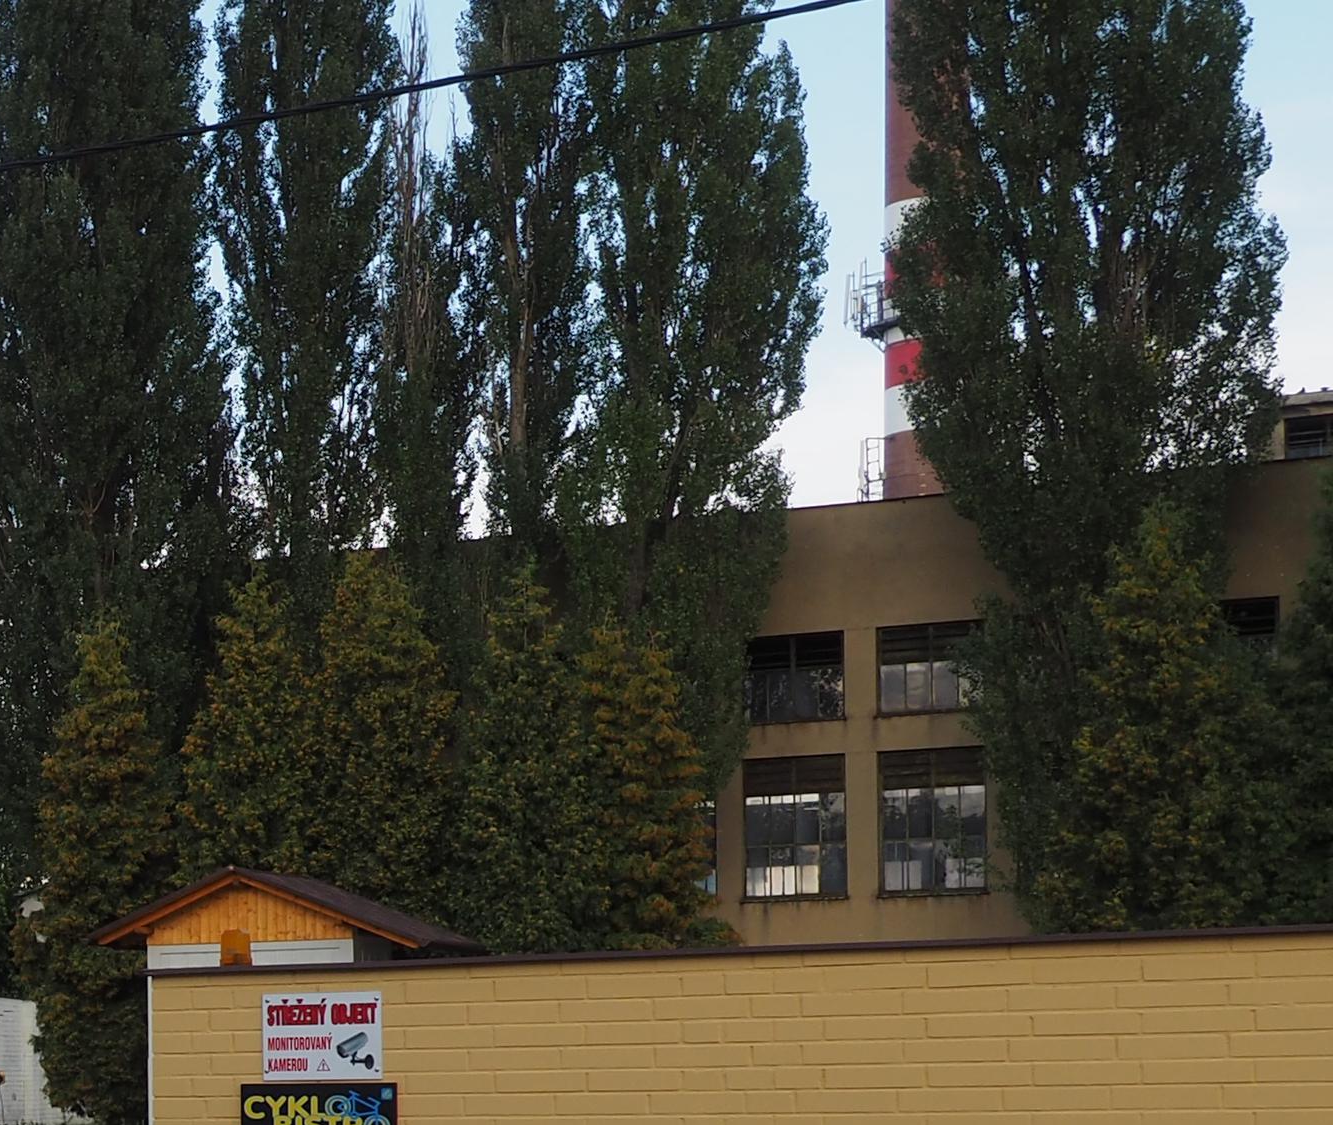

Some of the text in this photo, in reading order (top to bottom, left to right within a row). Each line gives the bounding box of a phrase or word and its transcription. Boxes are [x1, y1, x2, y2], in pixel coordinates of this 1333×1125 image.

[267, 998, 377, 1026] STŘEŽENÝ OBJEKT
[268, 1032, 332, 1051] MONITOROVANÝ
[268, 1058, 308, 1072] KAMEROU
[244, 1095, 351, 1119] CYKLO
